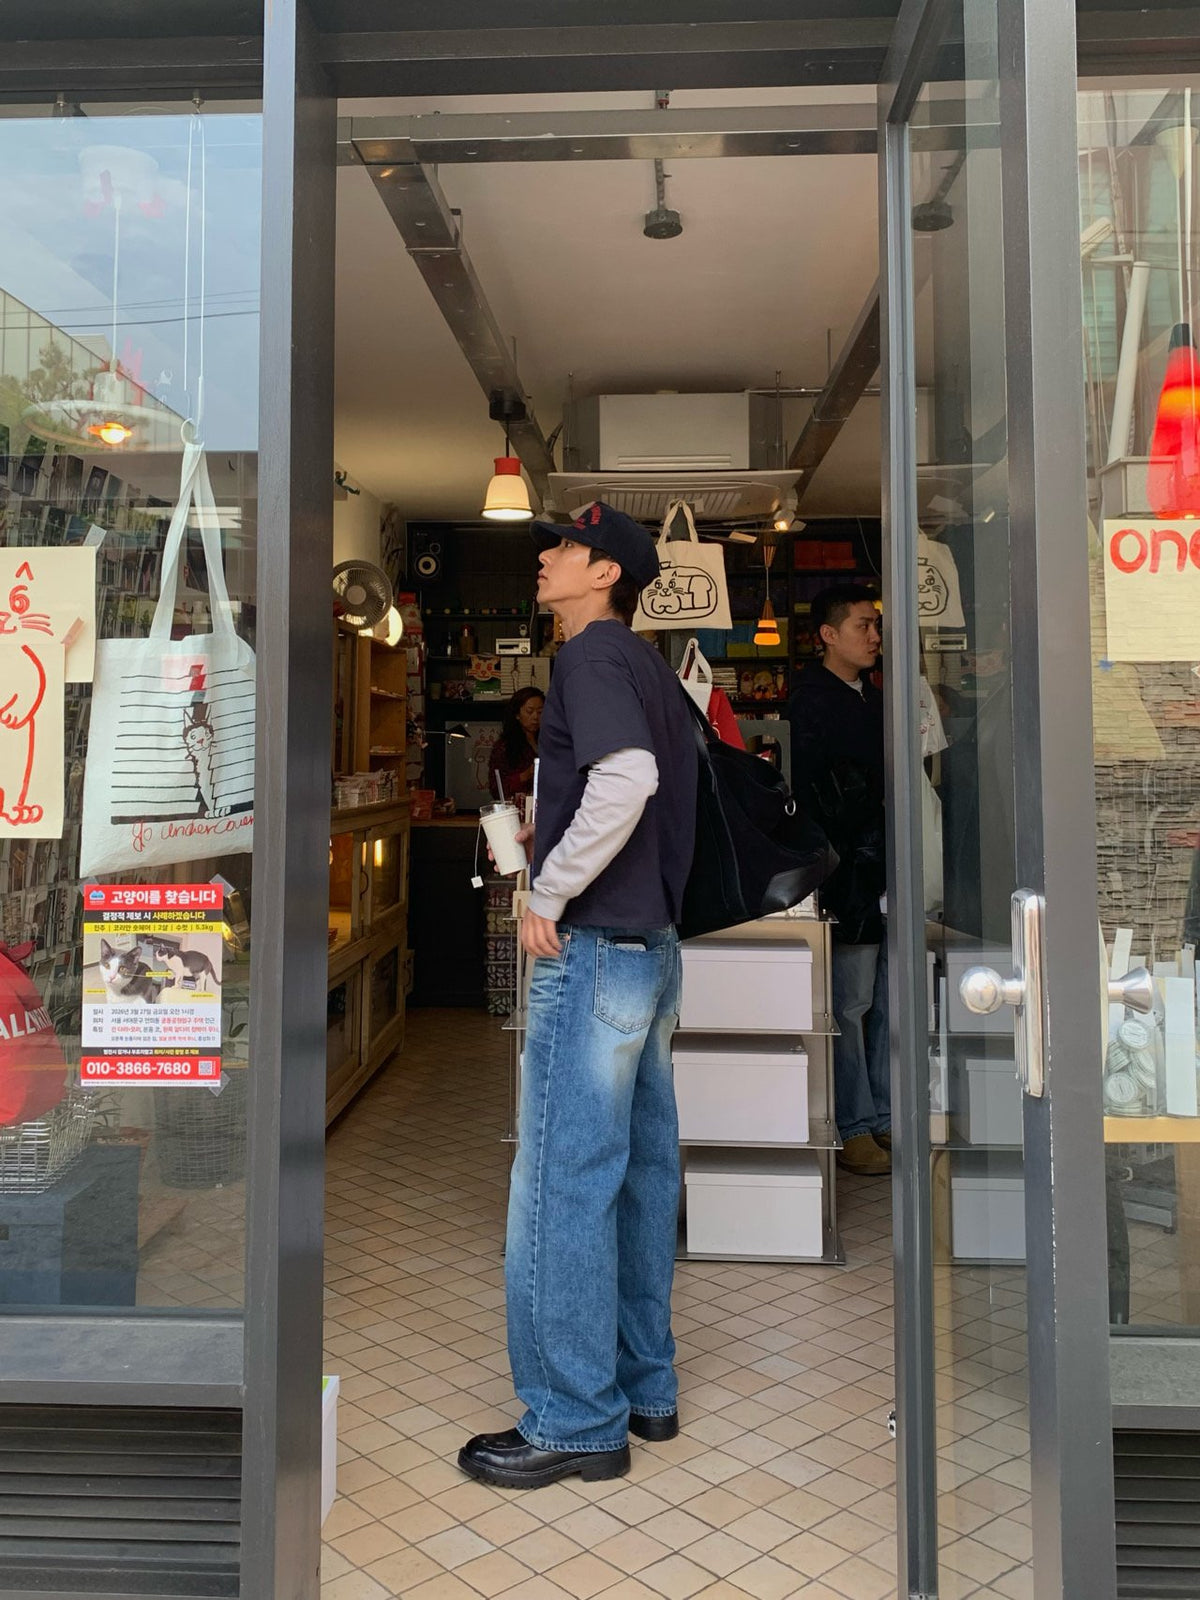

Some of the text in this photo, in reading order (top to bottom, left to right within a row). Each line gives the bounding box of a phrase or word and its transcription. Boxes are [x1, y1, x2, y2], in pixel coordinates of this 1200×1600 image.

[110, 890, 216, 905] 고양이를 찾습니다
[102, 912, 206, 920] 결정적 제보 시 사례하겠습니다
[86, 1062, 191, 1075] 010-3866-7680
